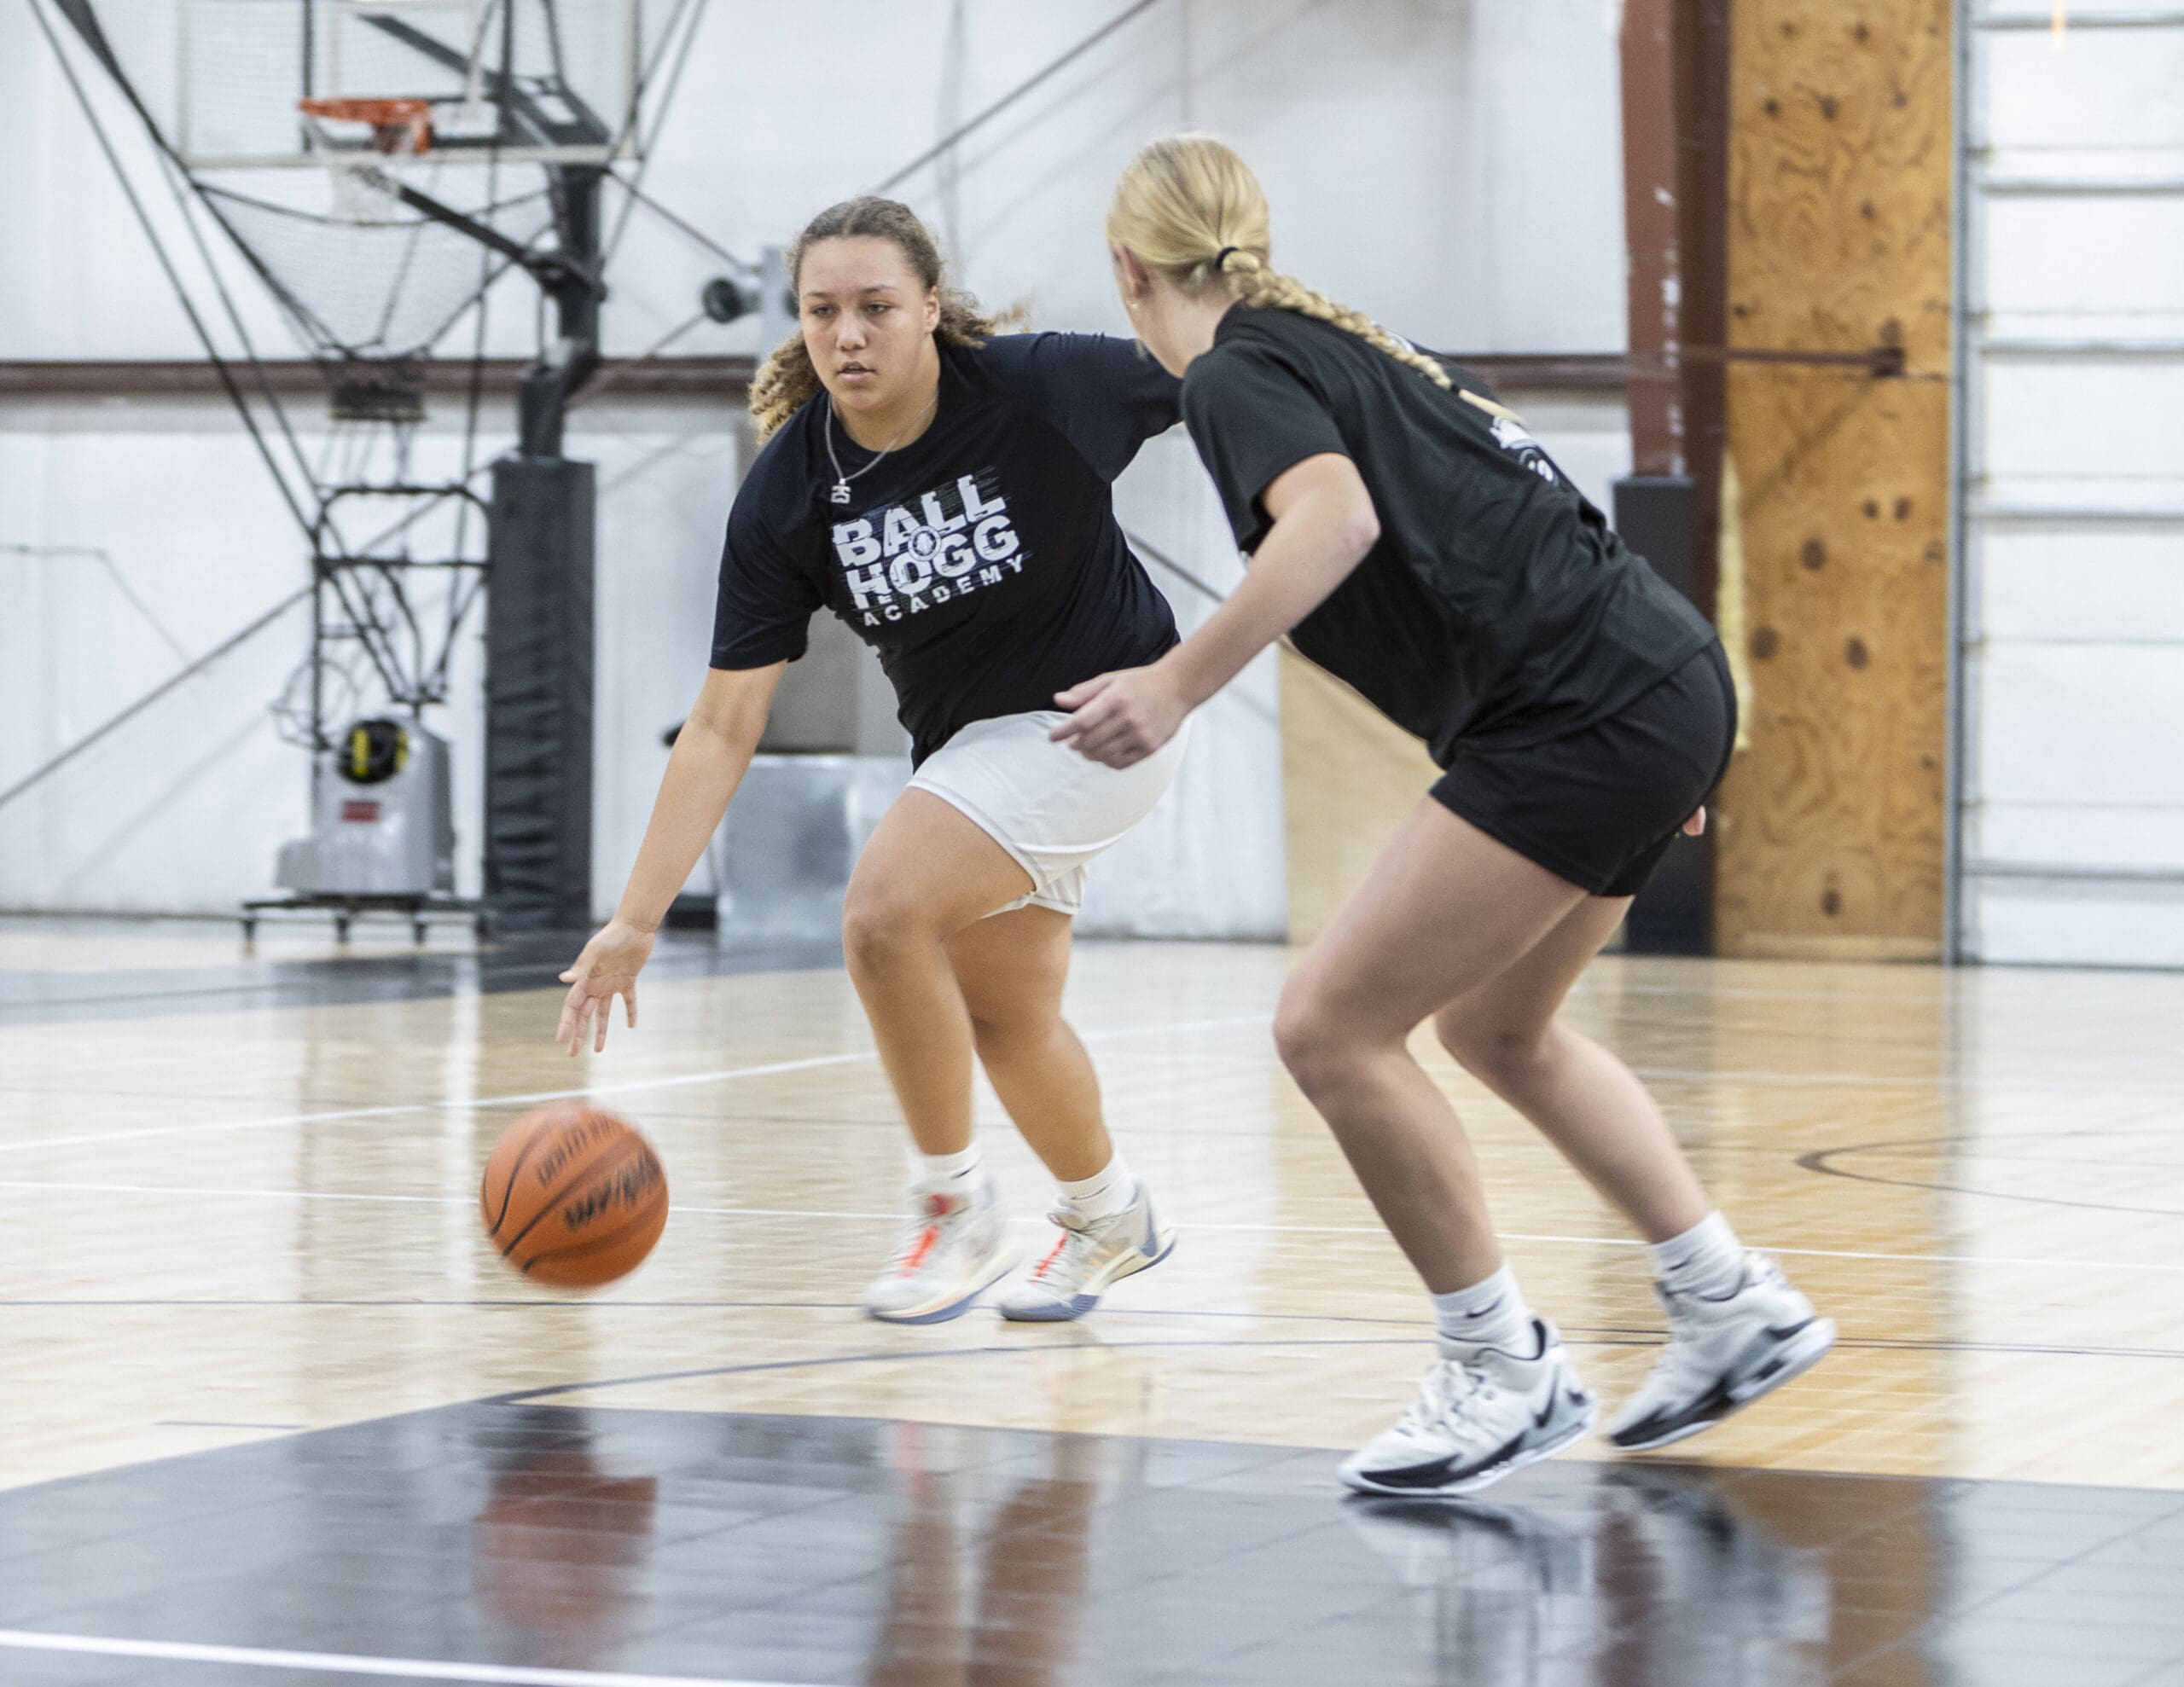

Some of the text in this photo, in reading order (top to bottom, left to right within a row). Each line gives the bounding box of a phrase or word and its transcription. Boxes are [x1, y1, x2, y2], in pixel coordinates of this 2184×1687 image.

[832, 474, 1006, 566] BALL
[845, 515, 1019, 609] HOGG
[863, 554, 1025, 626] ACADEMY
